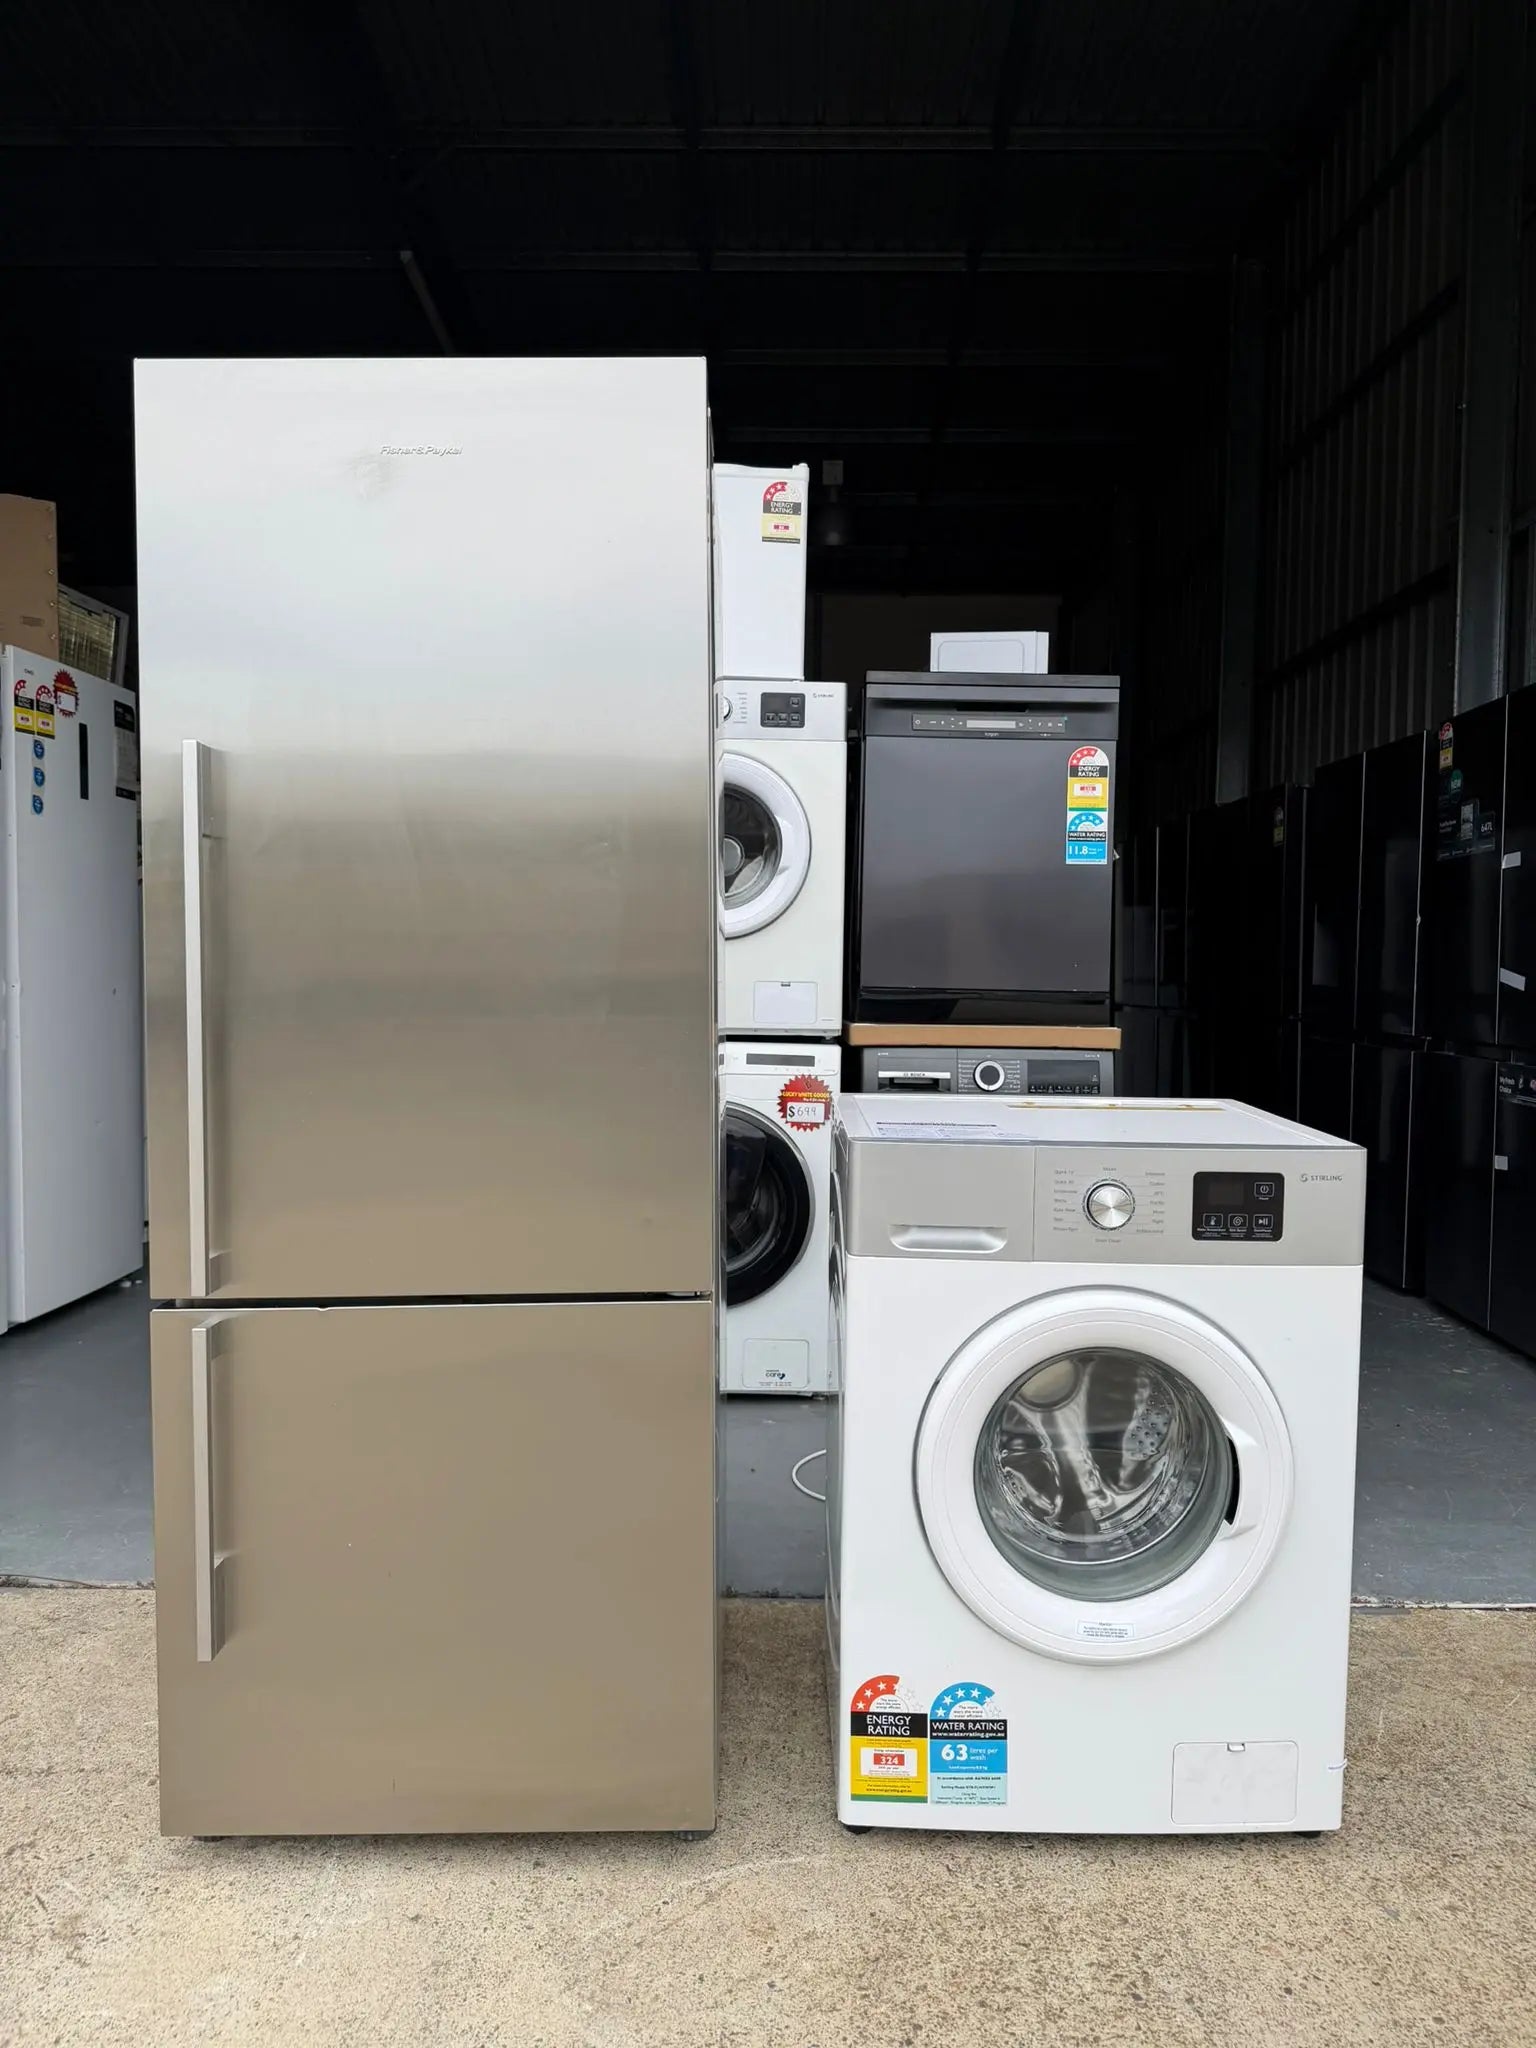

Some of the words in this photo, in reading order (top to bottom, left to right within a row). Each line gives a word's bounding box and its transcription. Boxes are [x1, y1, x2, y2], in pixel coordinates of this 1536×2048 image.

[1069, 845, 1089, 855] 11.8
[866, 1714, 911, 1725] ENERGY
[868, 1725, 910, 1736] RATING
[932, 1721, 966, 1730] WATER
[968, 1722, 1005, 1731] RATING
[941, 1744, 968, 1761] 63
[987, 1748, 998, 1756] per
[969, 1753, 987, 1761] wash
[880, 1756, 899, 1765] 324
